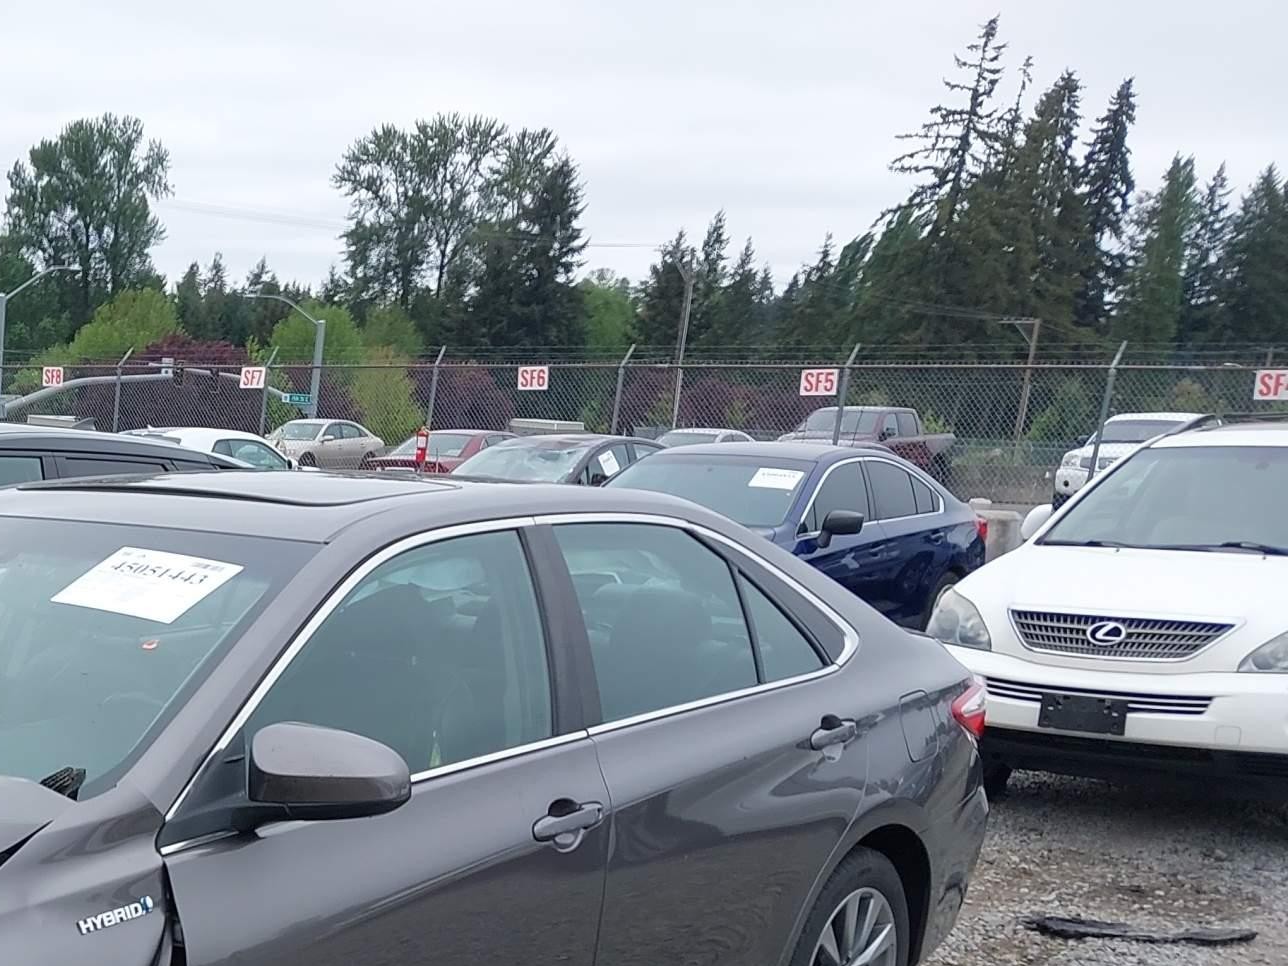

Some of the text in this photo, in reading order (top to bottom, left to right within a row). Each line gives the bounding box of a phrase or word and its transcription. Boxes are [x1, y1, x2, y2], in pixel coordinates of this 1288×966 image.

[44, 368, 62, 384] SF8
[243, 370, 263, 386] SF7
[520, 369, 546, 388] SF6
[803, 372, 835, 392] SF5
[1258, 372, 1288, 396] SF
[77, 902, 143, 935] HYBRID
